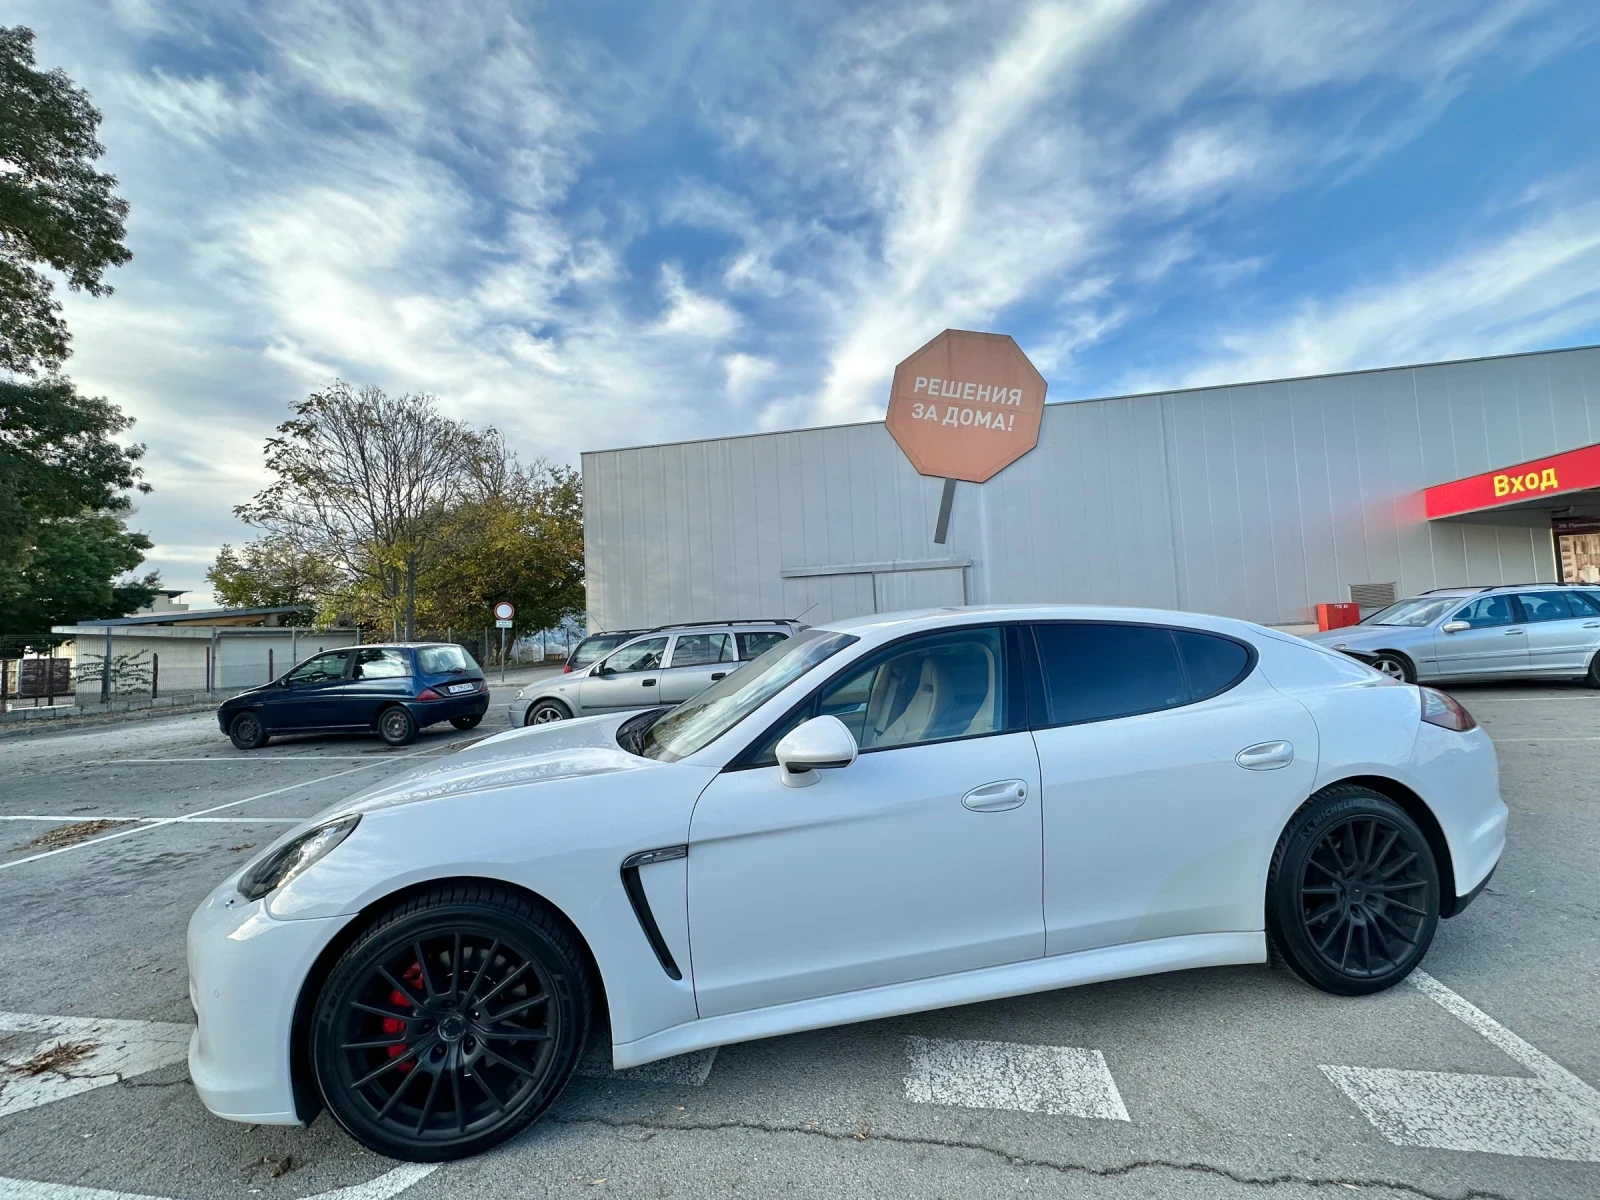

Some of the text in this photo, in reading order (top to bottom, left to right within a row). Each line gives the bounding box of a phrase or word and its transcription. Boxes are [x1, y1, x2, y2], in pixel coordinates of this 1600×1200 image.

[913, 376, 1022, 406] РЕШЕНИЯ
[911, 403, 1015, 432] ЗА ДОМА!
[1493, 468, 1559, 497] Вход
[1312, 799, 1360, 827] MICHELI
